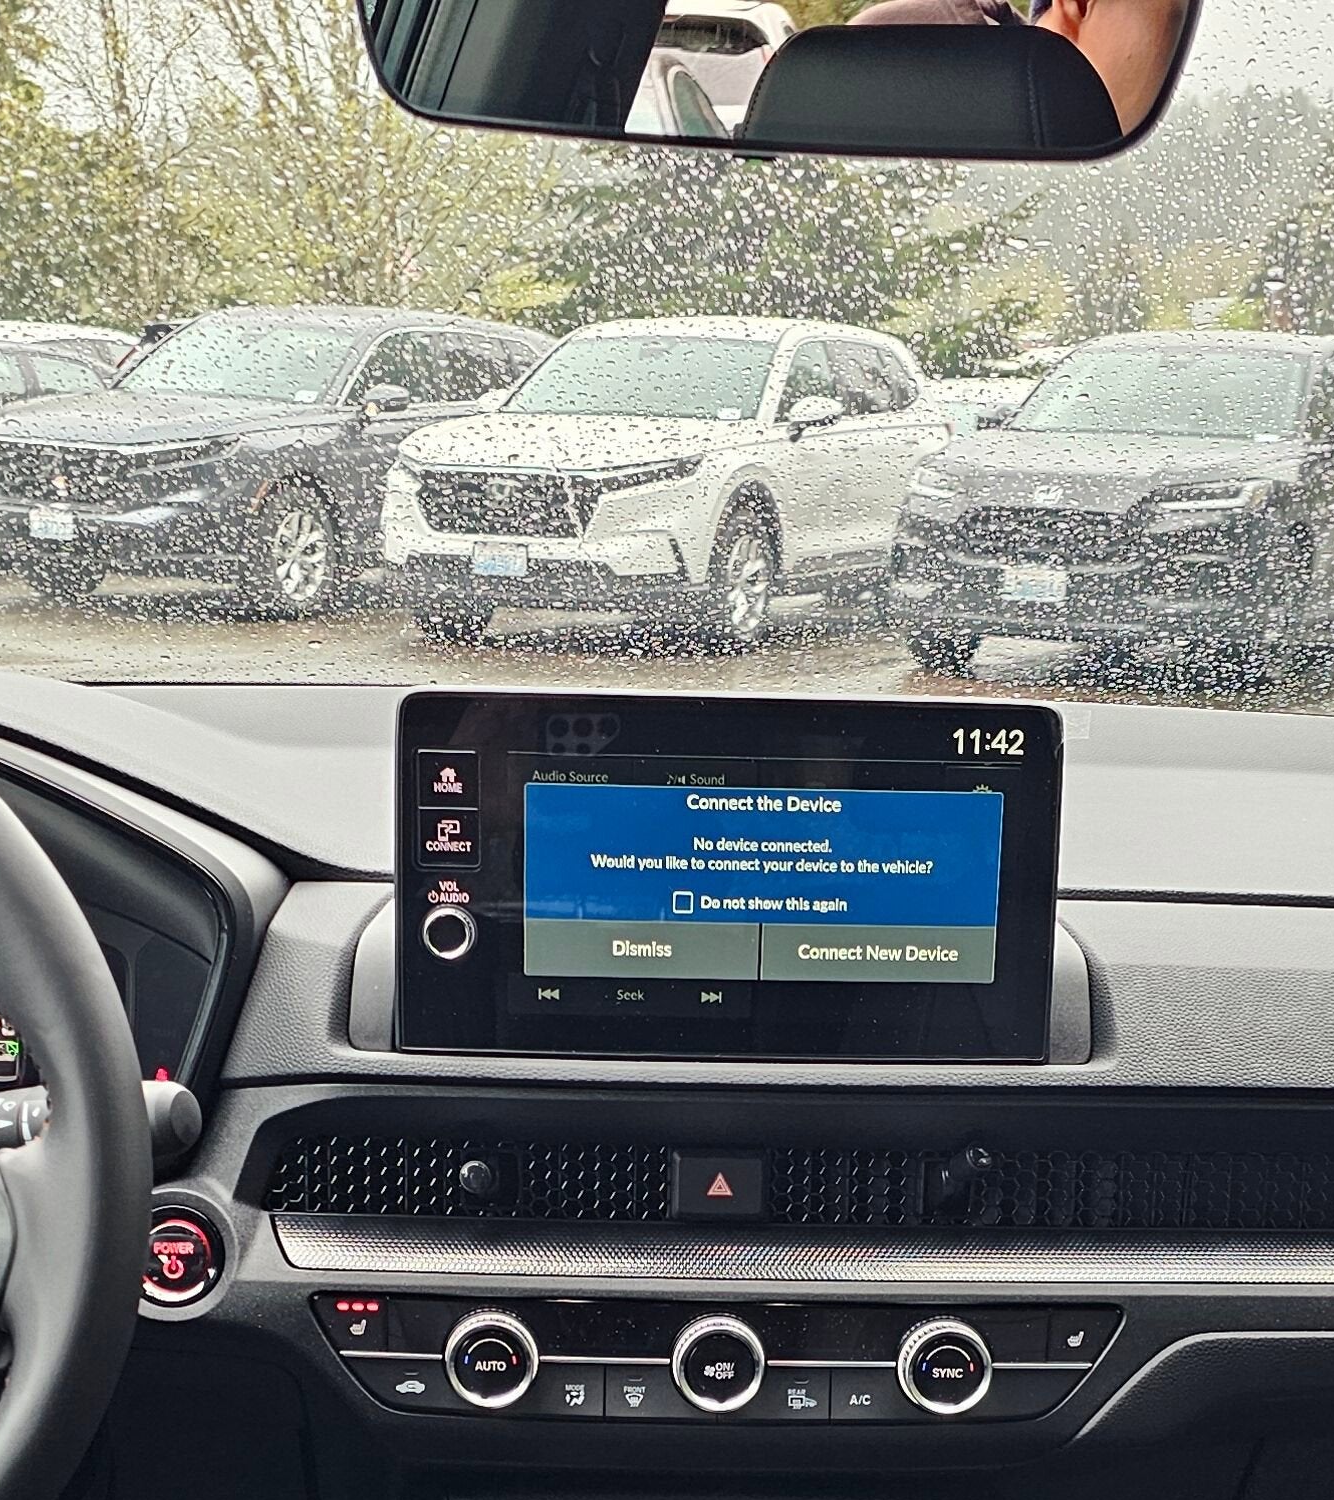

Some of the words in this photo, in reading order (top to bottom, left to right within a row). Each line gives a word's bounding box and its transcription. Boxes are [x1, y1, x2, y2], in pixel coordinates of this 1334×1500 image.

[952, 728, 1024, 755] 11:42
[532, 770, 567, 782] Audio
[569, 771, 609, 783] Source
[689, 774, 725, 786] Sound
[433, 782, 463, 794] HOME
[686, 794, 754, 812] Connect
[757, 795, 783, 812] the
[786, 796, 842, 813] Device
[425, 841, 472, 852] CONNECT
[693, 837, 714, 851] No
[716, 837, 759, 853] device
[760, 838, 833, 853] connected.
[590, 854, 636, 870] Would
[637, 858, 663, 872] you
[665, 855, 689, 870] like
[690, 857, 705, 870] to
[707, 858, 760, 872] connect
[762, 860, 794, 874] your
[795, 857, 838, 873] device
[840, 860, 856, 873] to
[857, 858, 880, 874] the
[882, 859, 933, 875] vehicle?
[438, 881, 460, 892] VOL
[439, 892, 470, 904] AUDIO
[700, 896, 720, 910] Do
[722, 896, 745, 910] not
[747, 896, 784, 911] show
[785, 896, 810, 911] this
[812, 897, 848, 914] again
[612, 940, 673, 958] Dismiss
[797, 943, 863, 961] Connect
[865, 944, 901, 961] New
[904, 945, 959, 963] Device
[616, 988, 645, 1001] Seek
[153, 1241, 195, 1255] POWER
[474, 1360, 507, 1373] AUTO
[714, 1362, 735, 1372] ON/
[714, 1371, 735, 1380] OFF
[931, 1367, 964, 1380] SYNC
[565, 1384, 585, 1392] MODE
[623, 1385, 646, 1394] FRONT
[849, 1393, 871, 1407] A/C
